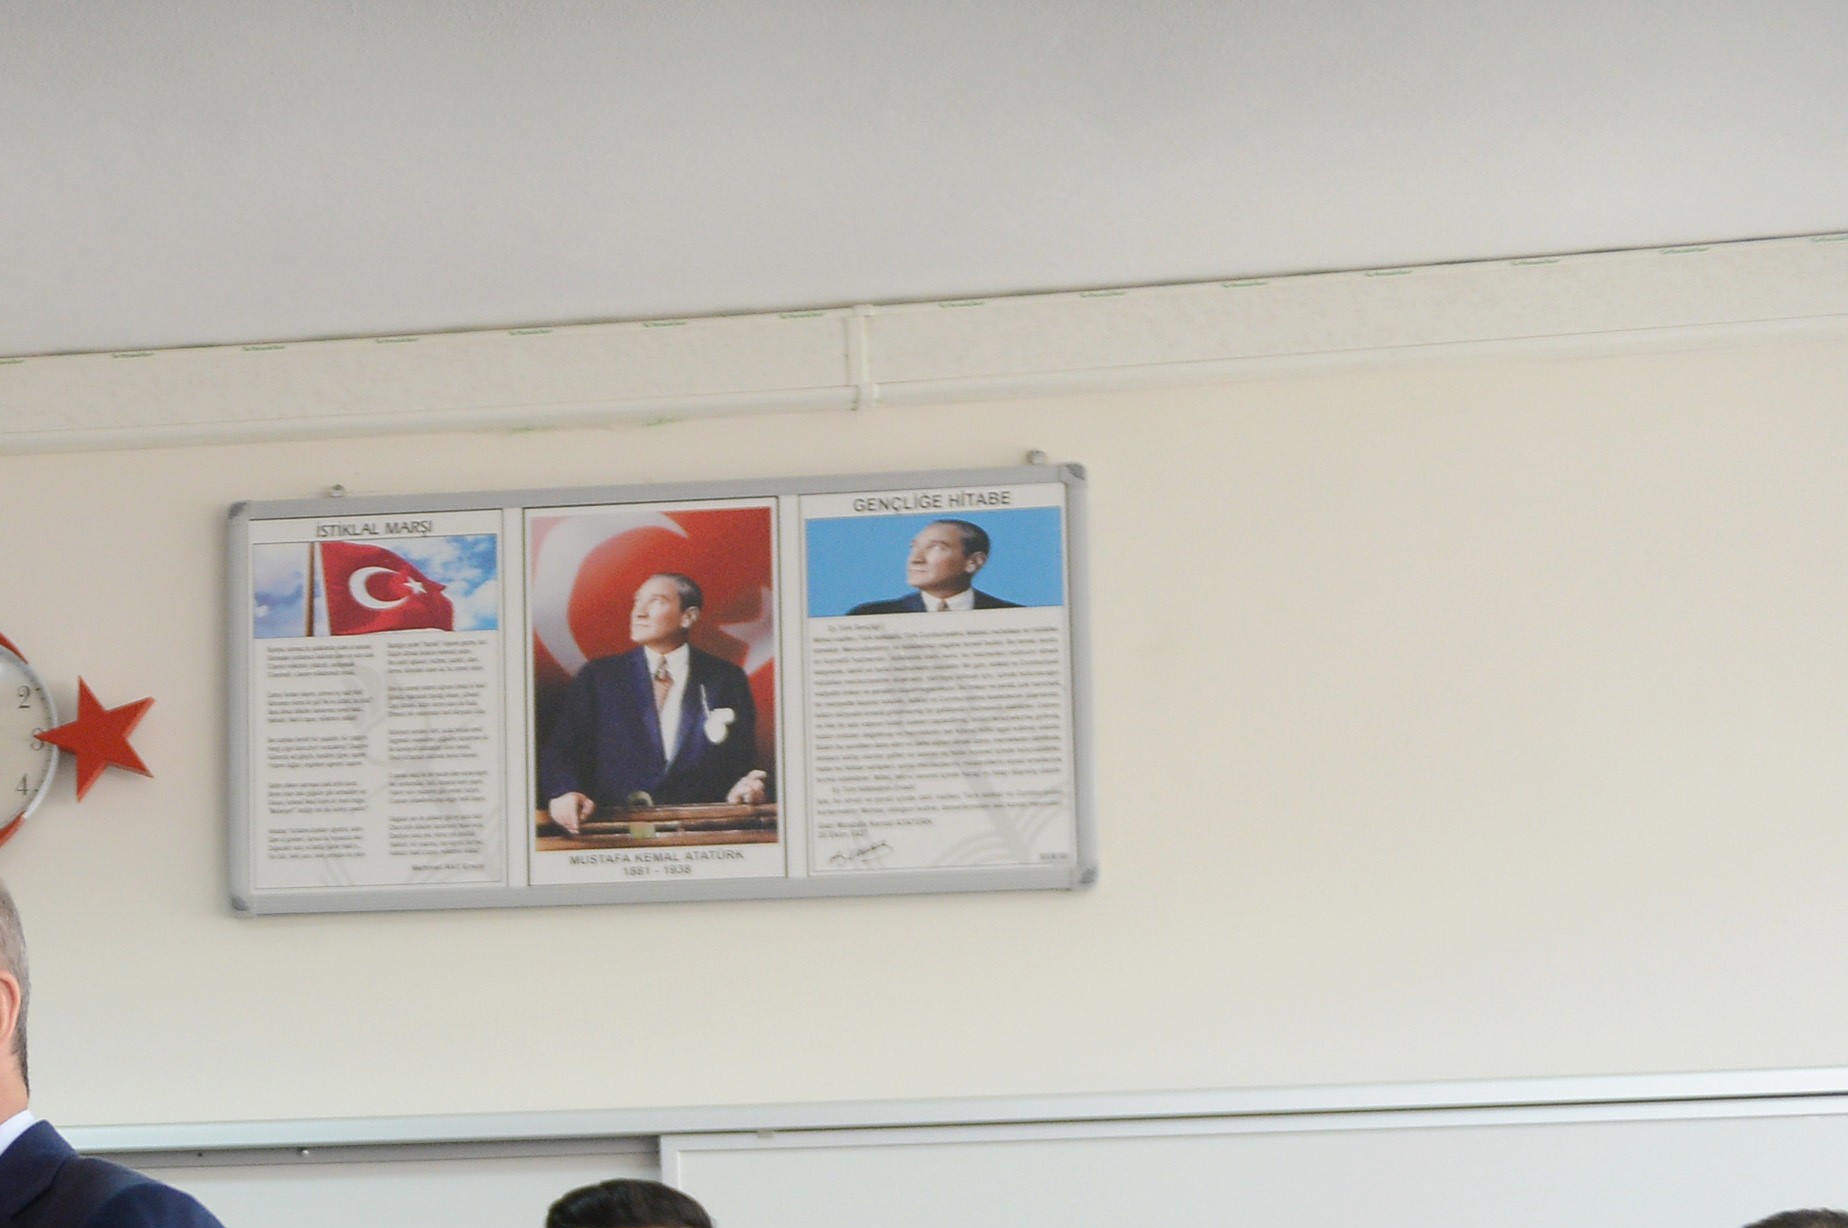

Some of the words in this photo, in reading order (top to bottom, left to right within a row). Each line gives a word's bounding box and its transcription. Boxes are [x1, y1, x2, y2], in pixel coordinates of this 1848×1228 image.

[853, 493, 942, 512] GENÇLİĞE
[949, 490, 1011, 507] HİTABE
[316, 520, 379, 537] İSTİKLAL
[384, 520, 432, 538] MARŞI
[17, 685, 31, 709] 2
[15, 773, 29, 796] 4
[569, 853, 631, 865] MUSTAFA
[635, 852, 680, 863] KEMAL
[685, 847, 744, 861] ATATÜRK
